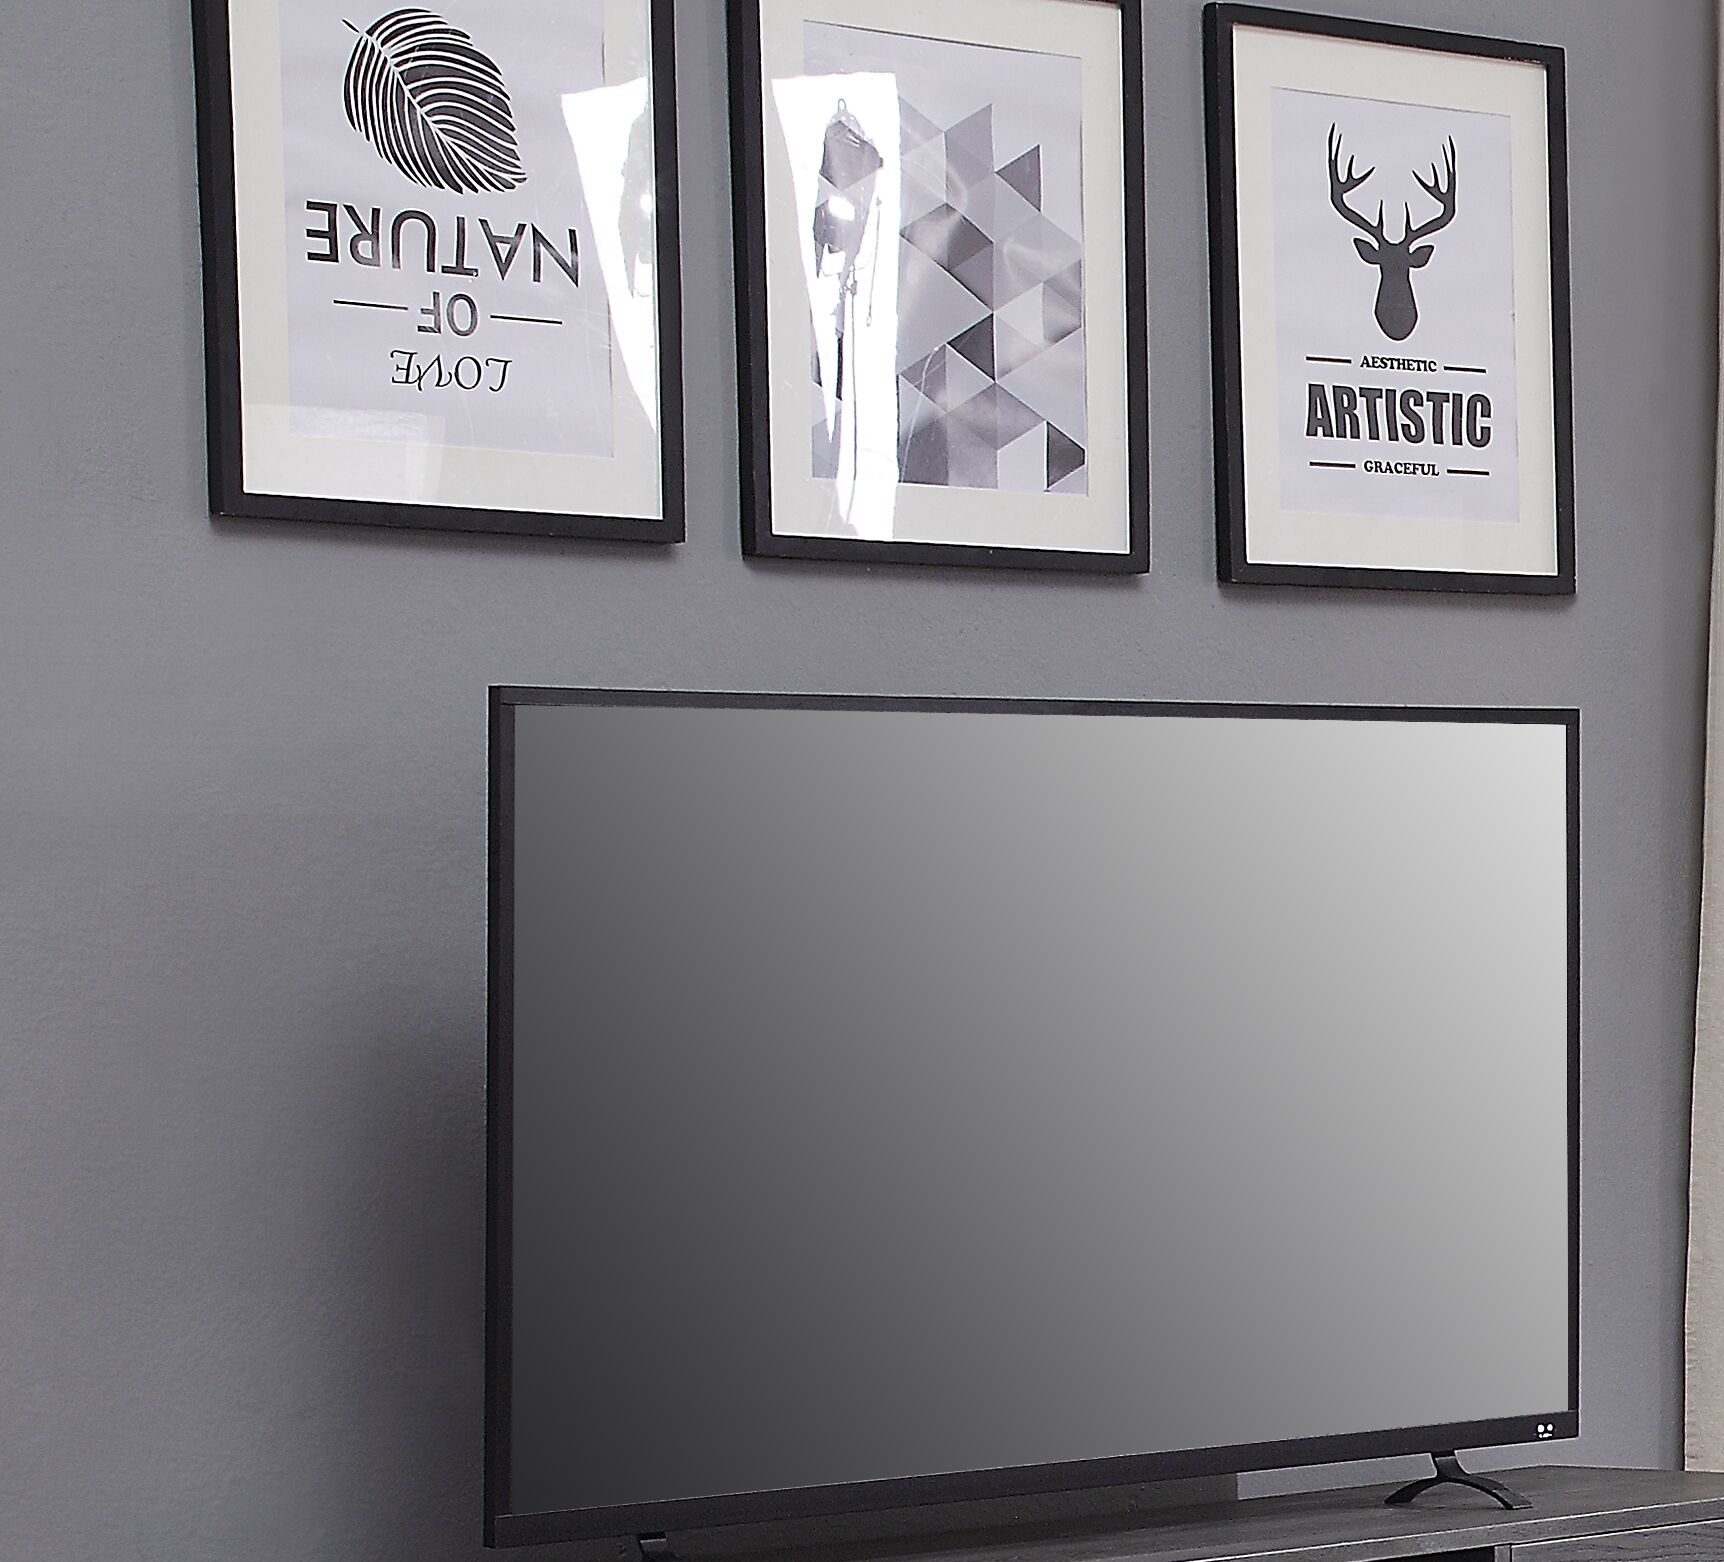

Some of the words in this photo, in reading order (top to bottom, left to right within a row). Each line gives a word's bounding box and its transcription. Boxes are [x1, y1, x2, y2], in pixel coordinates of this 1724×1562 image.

[306, 200, 579, 288] NATURE
[417, 291, 479, 337] OF
[390, 349, 513, 393] LOVE
[1359, 355, 1438, 373] AESTHETIC
[1305, 383, 1492, 449] ARTISTIC
[1363, 460, 1440, 477] GRACEFUL
